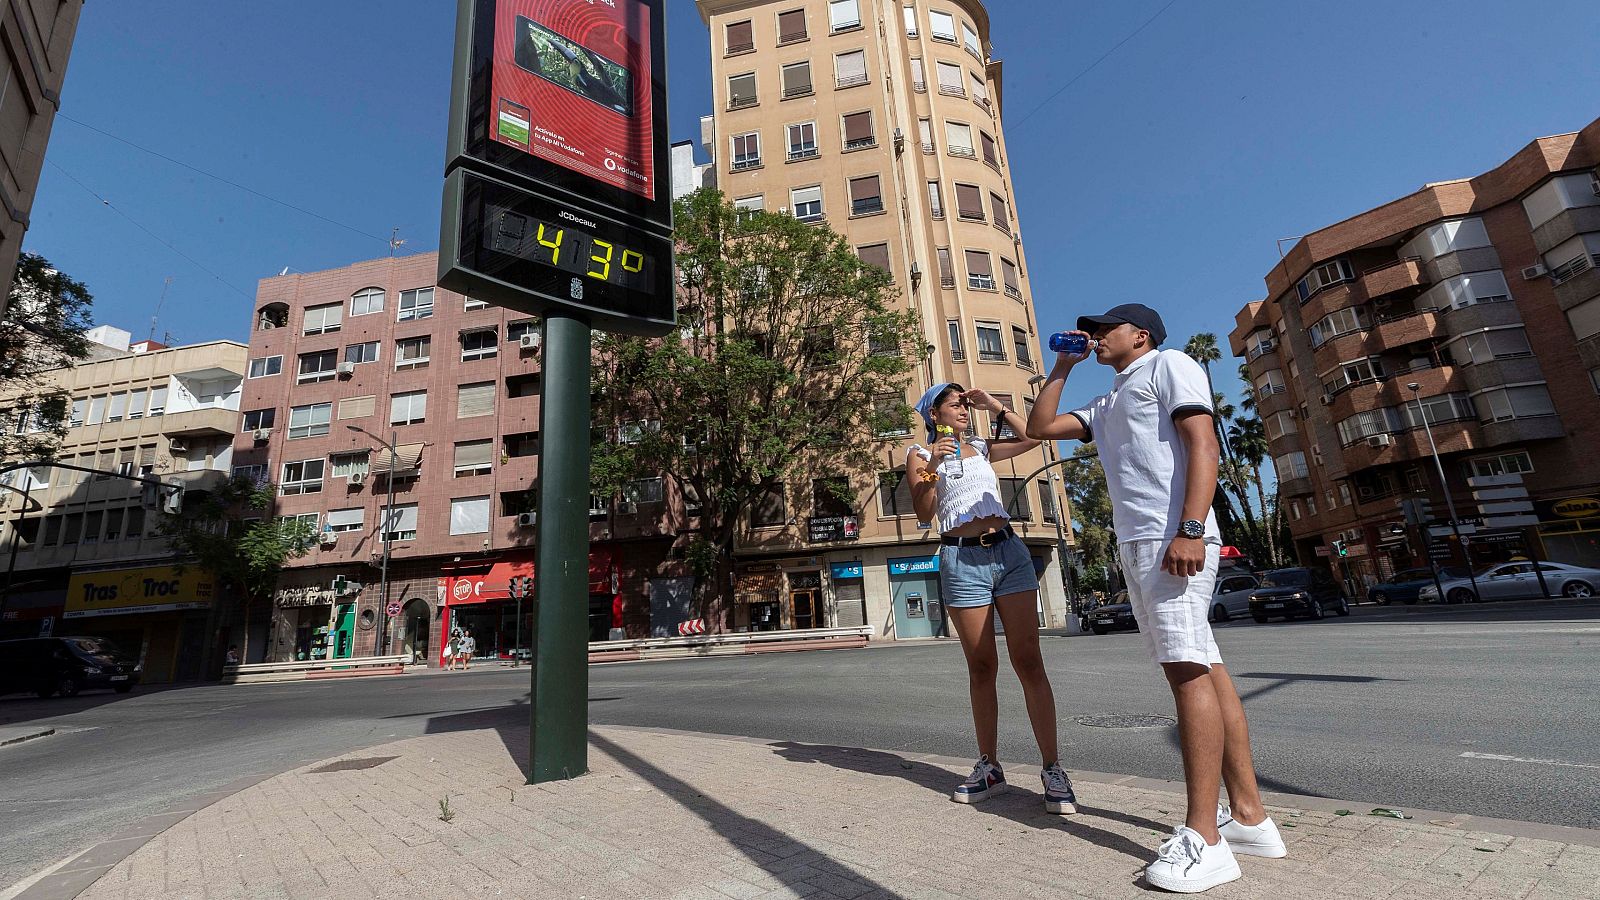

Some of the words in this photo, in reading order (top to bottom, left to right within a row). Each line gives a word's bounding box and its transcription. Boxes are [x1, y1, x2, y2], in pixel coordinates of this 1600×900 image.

[541, 135, 553, 144] App
[560, 142, 585, 157] Vodafone
[617, 165, 648, 183] vodafone
[558, 210, 597, 229] JCDecaux
[899, 561, 934, 572] Sabadell
[83, 583, 117, 602] Tras
[143, 577, 180, 597] Troc
[455, 584, 470, 596] STOP
[276, 594, 334, 607] CARMELITANA
